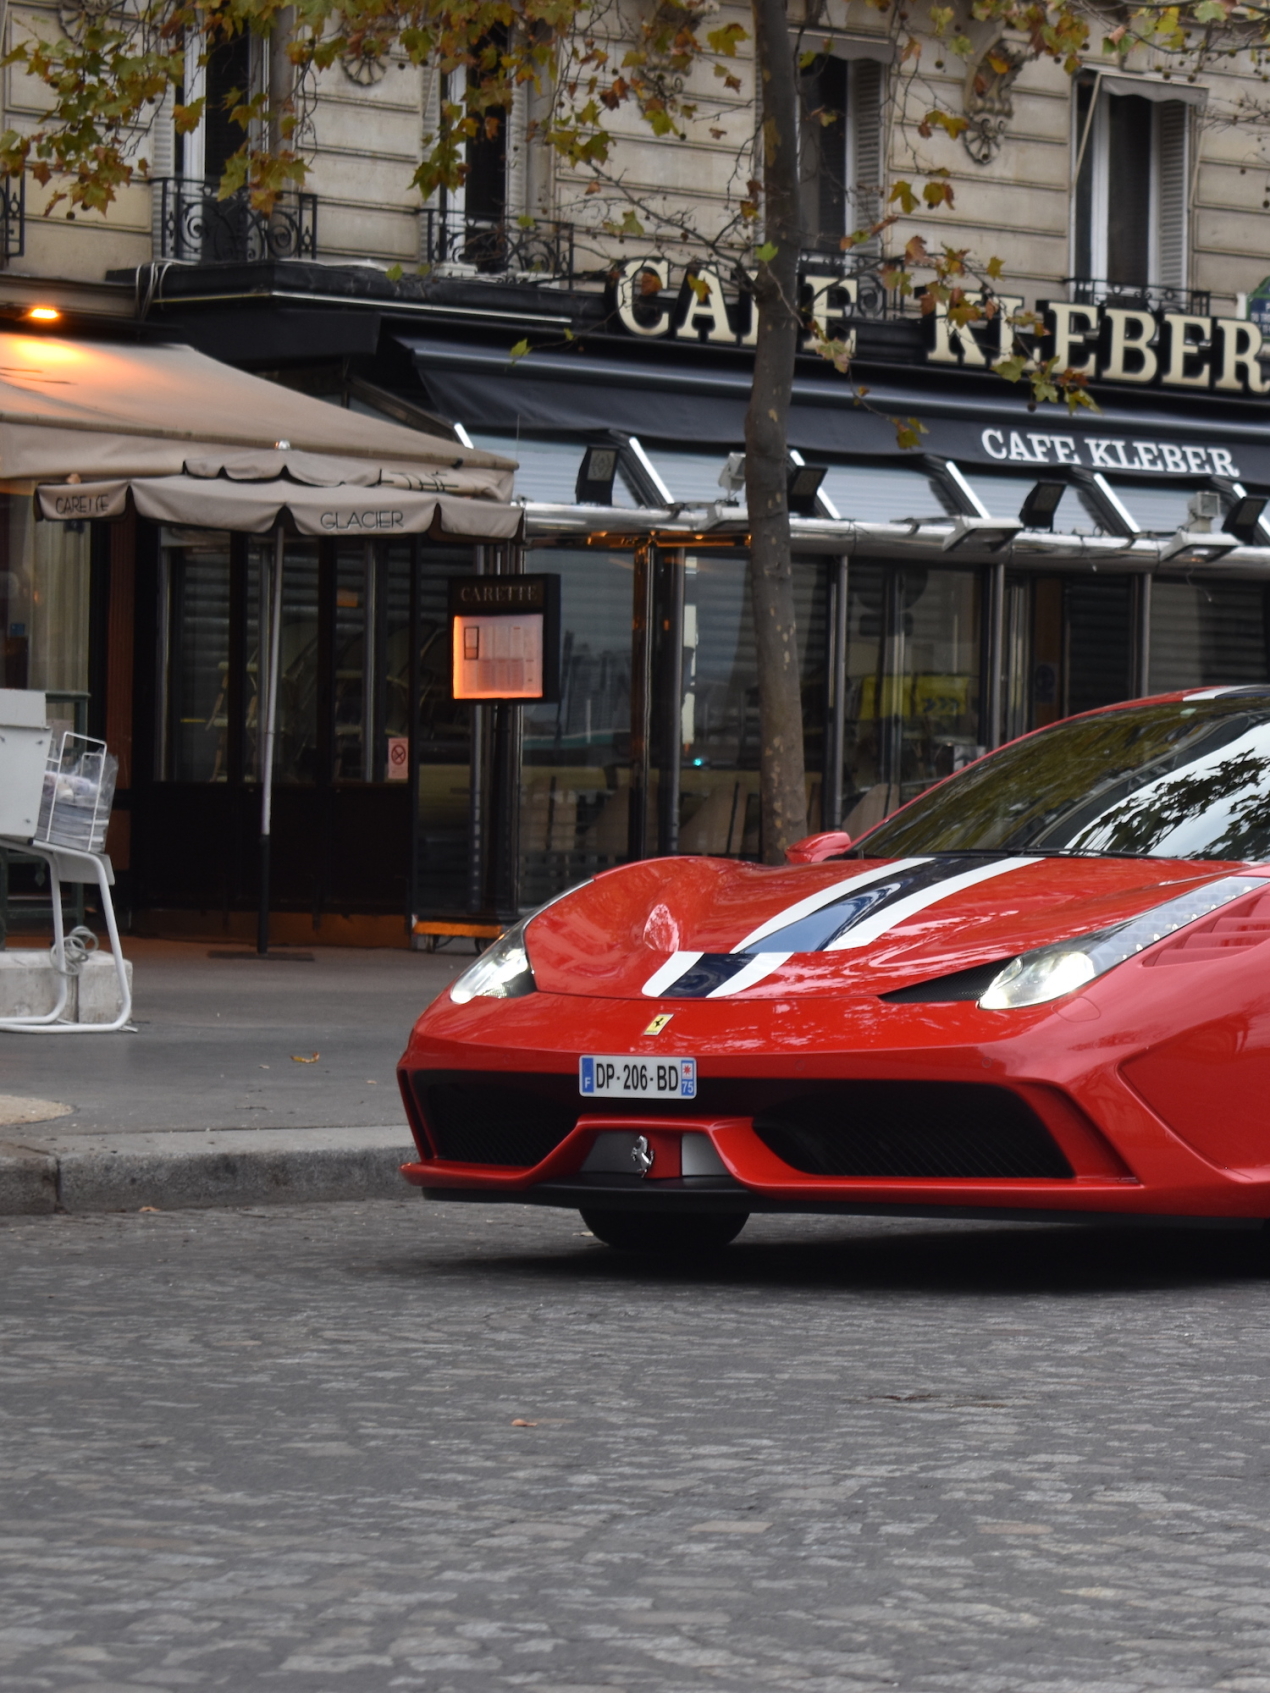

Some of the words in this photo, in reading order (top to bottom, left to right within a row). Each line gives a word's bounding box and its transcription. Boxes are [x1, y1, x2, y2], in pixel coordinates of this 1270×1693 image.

[617, 258, 858, 354] CAE
[981, 428, 1082, 466] CAFE
[1084, 437, 1240, 478] KLEBER
[320, 510, 405, 530] GLACIER
[460, 586, 538, 602] CARETTE
[584, 1077, 591, 1088] F
[682, 1081, 694, 1094] 75
